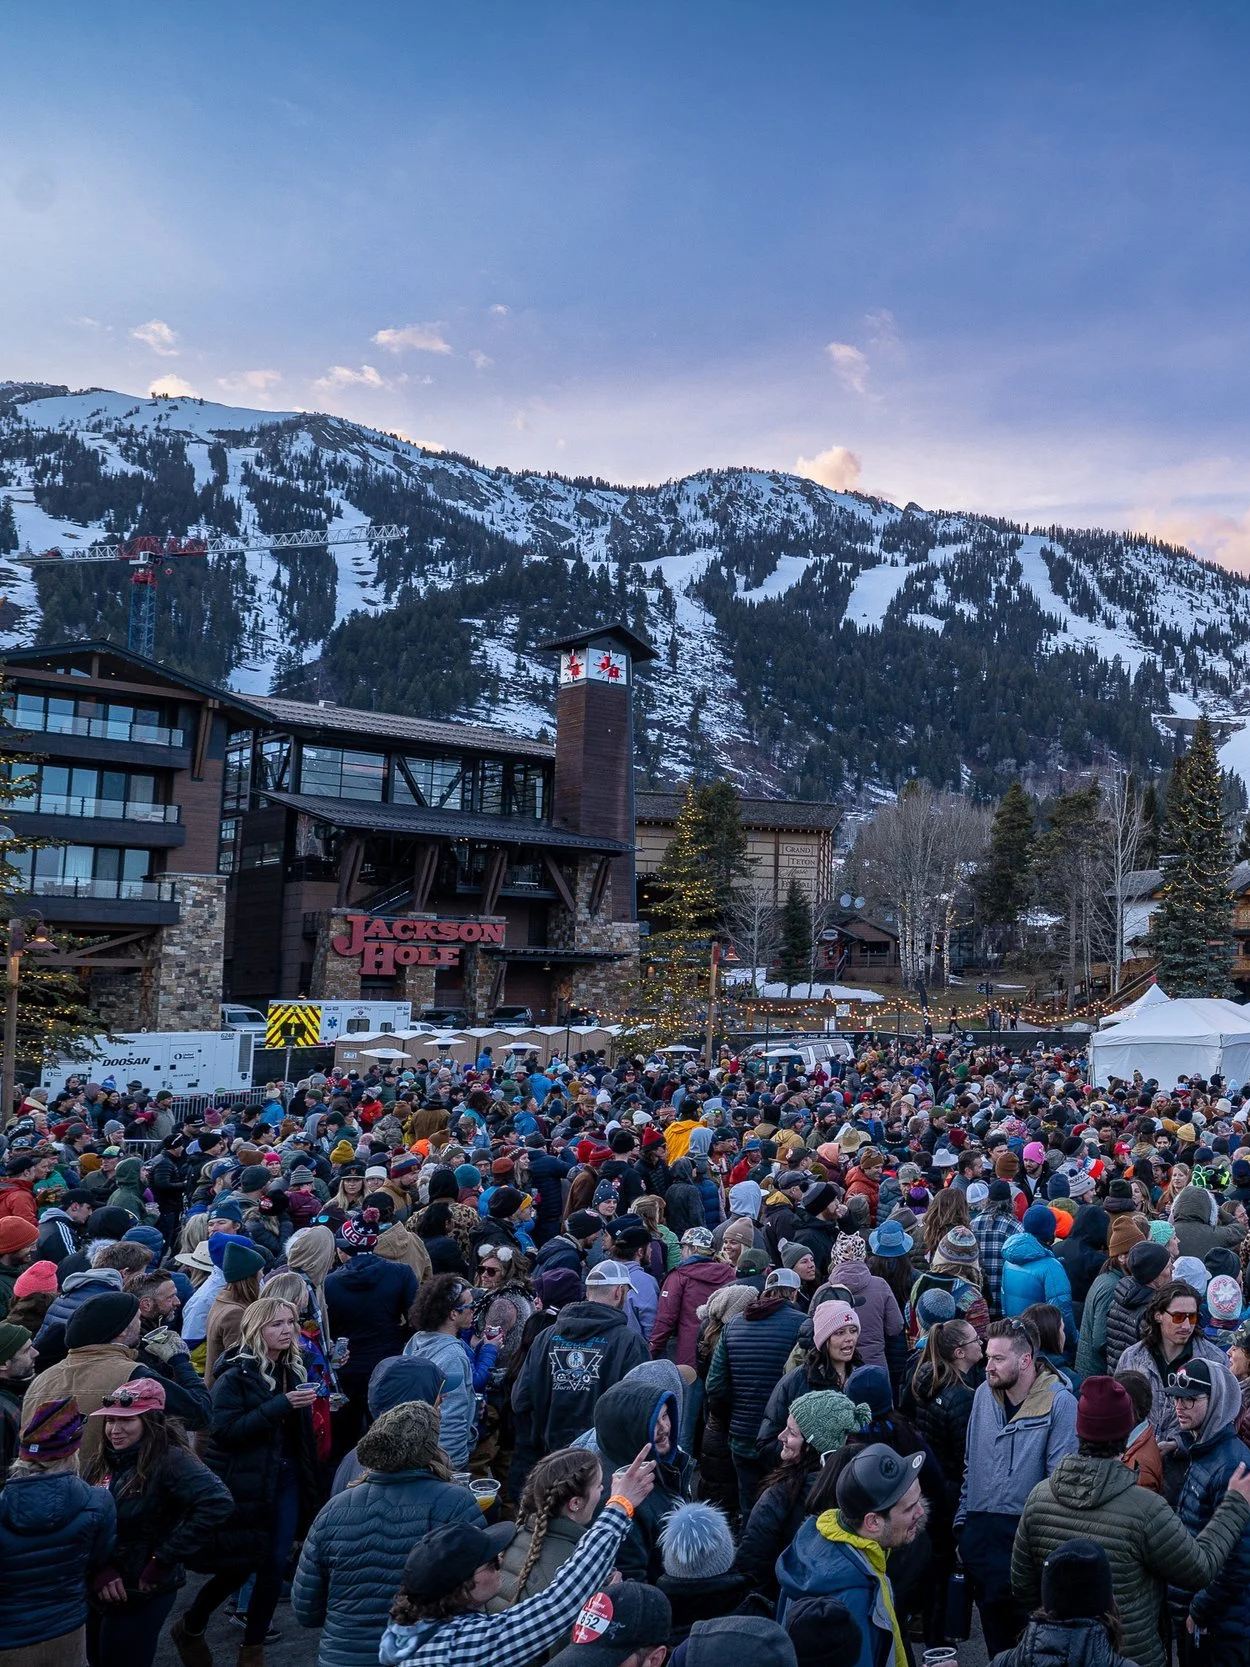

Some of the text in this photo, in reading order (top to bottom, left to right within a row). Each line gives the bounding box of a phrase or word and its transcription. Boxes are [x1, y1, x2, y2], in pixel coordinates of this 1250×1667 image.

[784, 845, 811, 854] GRAND
[790, 857, 816, 866] TETON
[781, 880, 810, 889] FEVAL
[332, 915, 506, 957] JACKSON
[359, 941, 460, 976] HOLE
[102, 1056, 151, 1067] DOOSAN
[344, 1226, 368, 1246] USA
